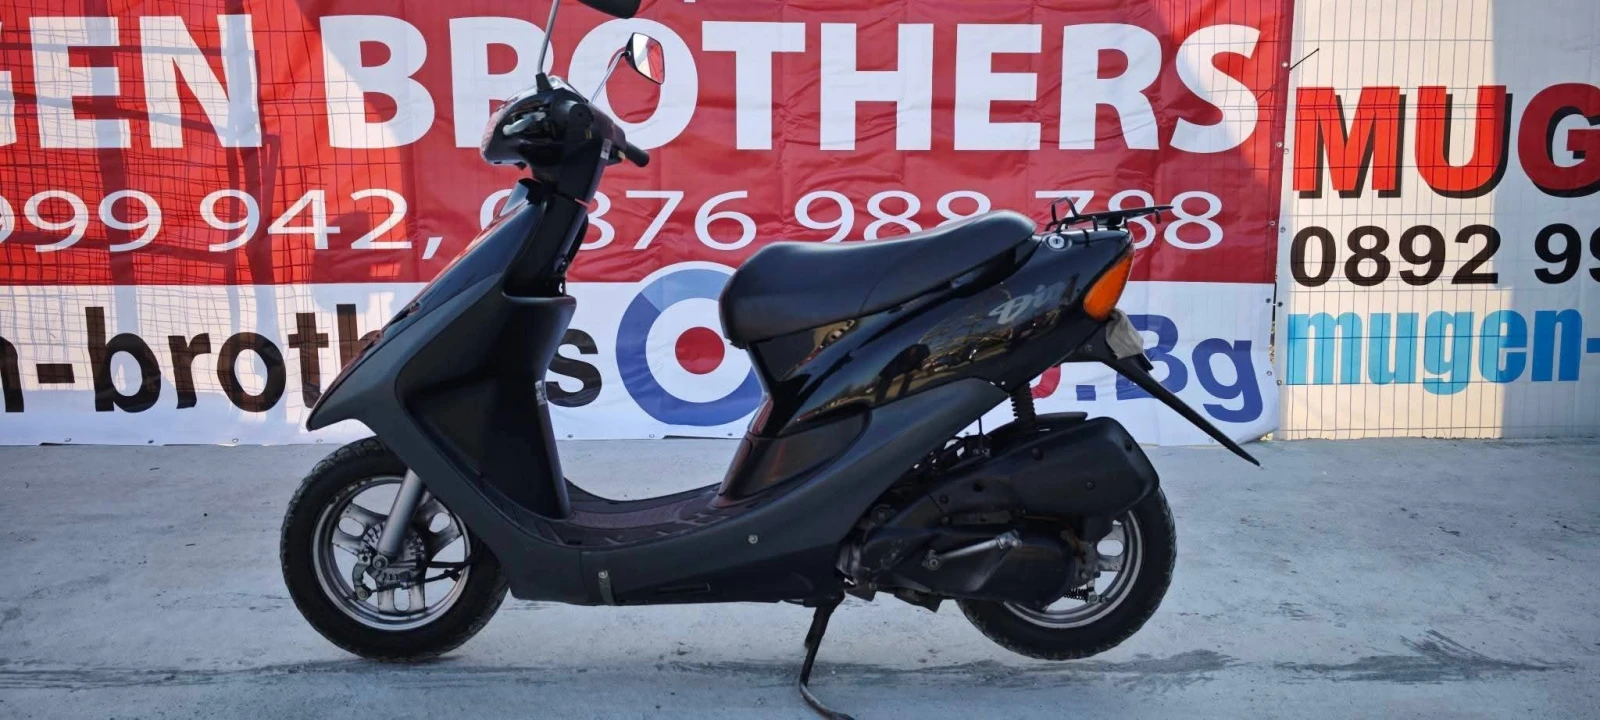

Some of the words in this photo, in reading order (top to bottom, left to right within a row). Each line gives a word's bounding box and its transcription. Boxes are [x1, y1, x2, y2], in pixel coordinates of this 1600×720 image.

[0, 14, 262, 149] EN
[319, 14, 1261, 153] BROTHERS
[0, 189, 162, 252] 99
[200, 188, 443, 260] 942,
[1290, 224, 1502, 287] 0892
[1534, 222, 1600, 285] 9
[0, 303, 602, 414] -brots
[1285, 308, 1600, 396] mugen-
